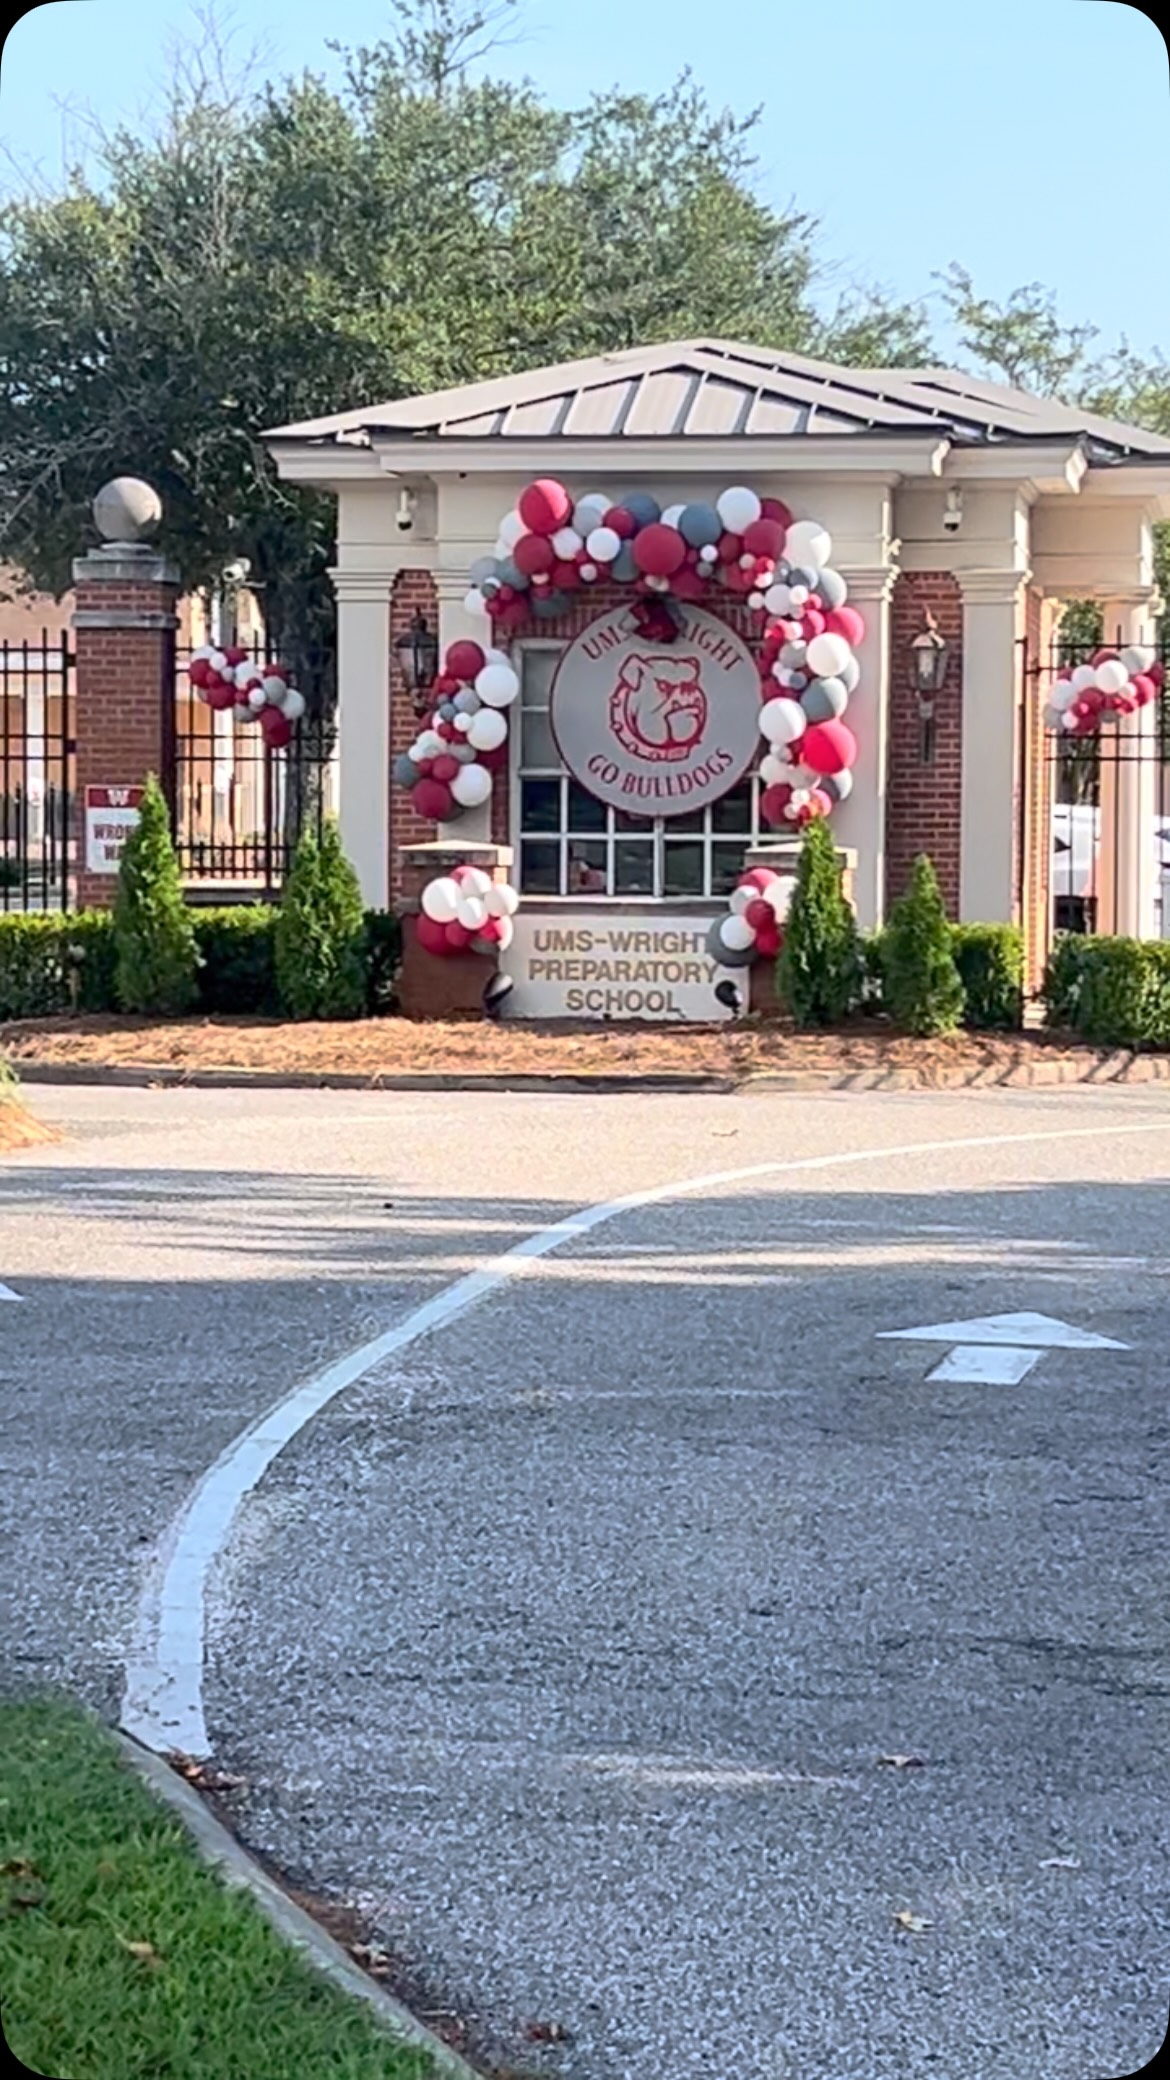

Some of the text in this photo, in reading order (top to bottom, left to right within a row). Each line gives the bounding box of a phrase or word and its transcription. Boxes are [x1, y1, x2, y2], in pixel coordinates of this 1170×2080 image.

[588, 747, 734, 798] GO BULLDOGS
[528, 958, 719, 984] PREPARATORY
[566, 988, 681, 1012] SCHOOL
